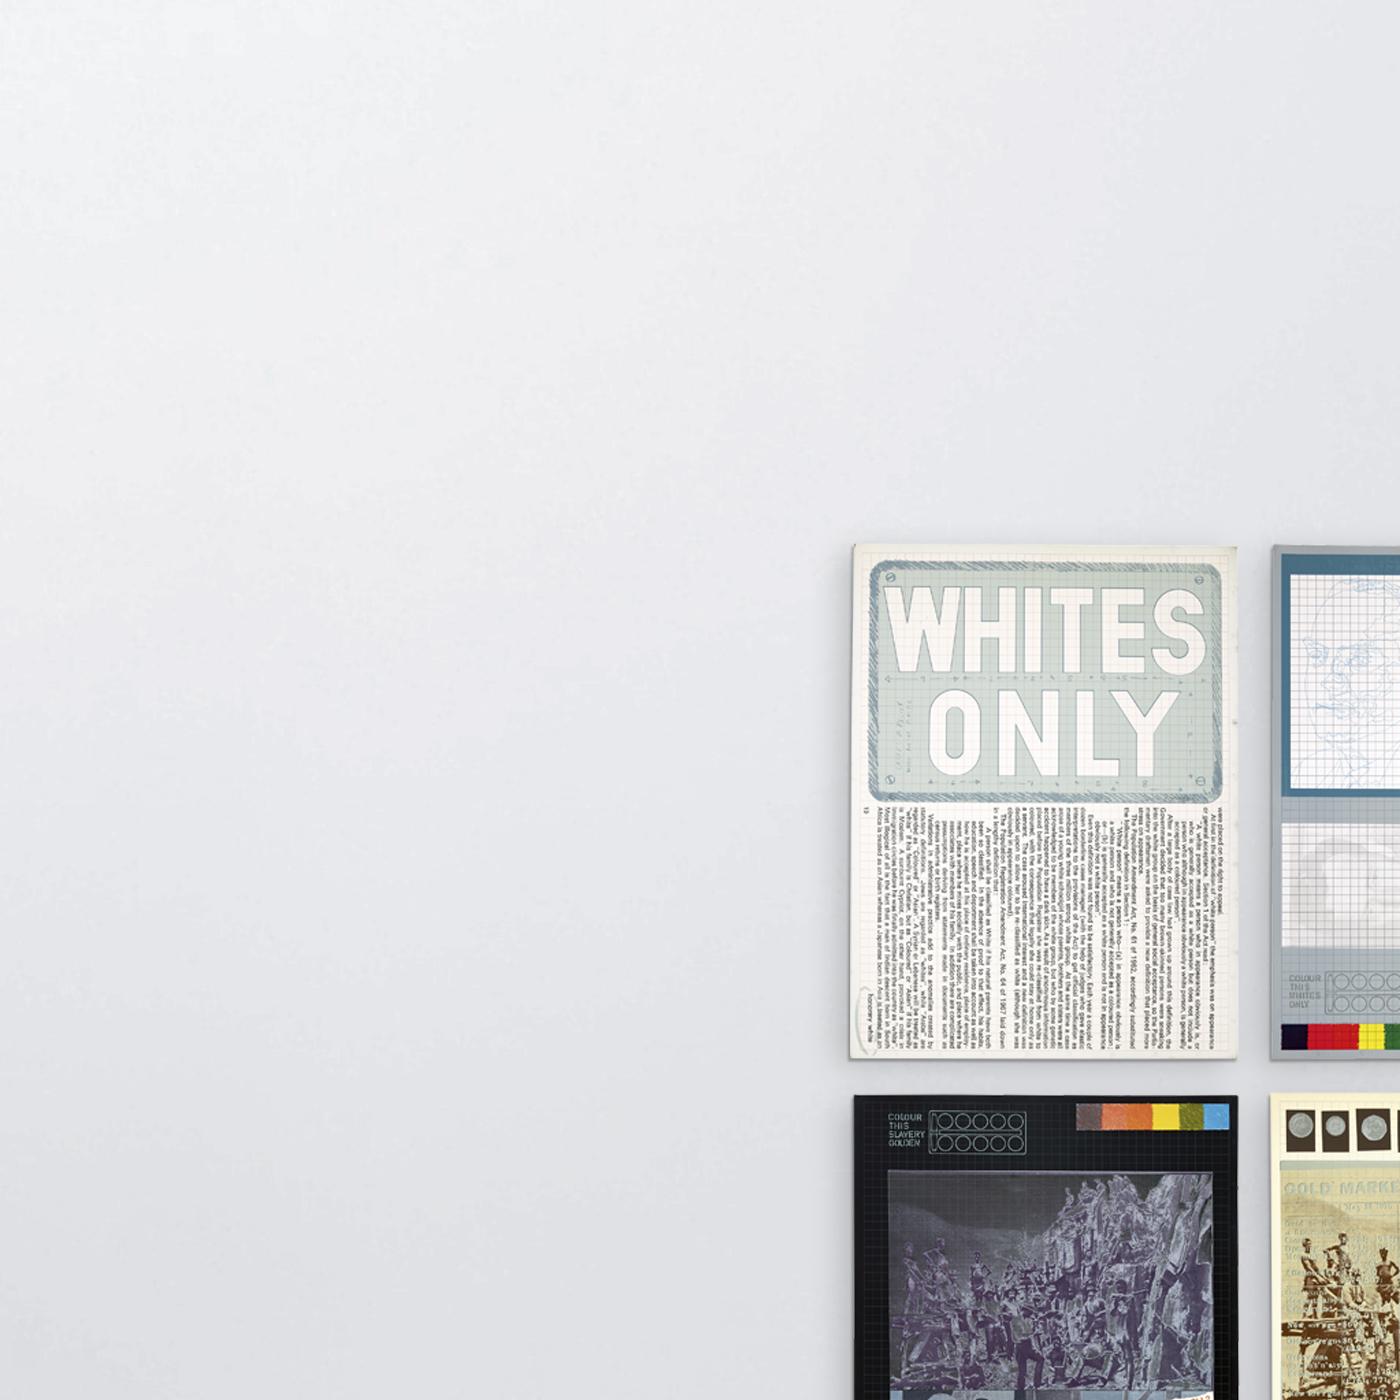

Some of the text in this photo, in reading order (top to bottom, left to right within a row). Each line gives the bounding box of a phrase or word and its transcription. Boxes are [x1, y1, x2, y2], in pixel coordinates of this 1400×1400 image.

[883, 585, 1207, 676] WHITES
[929, 688, 1184, 778] ONLY
[1289, 974, 1321, 982] COLOUR
[1289, 1000, 1310, 1008] ONLY
[888, 1113, 922, 1121] COLOUR
[889, 1122, 910, 1130] THIS
[889, 1131, 926, 1139] SLAVERY
[888, 1139, 921, 1147] GOLDEN
[1284, 1182, 1333, 1194] GOLD
